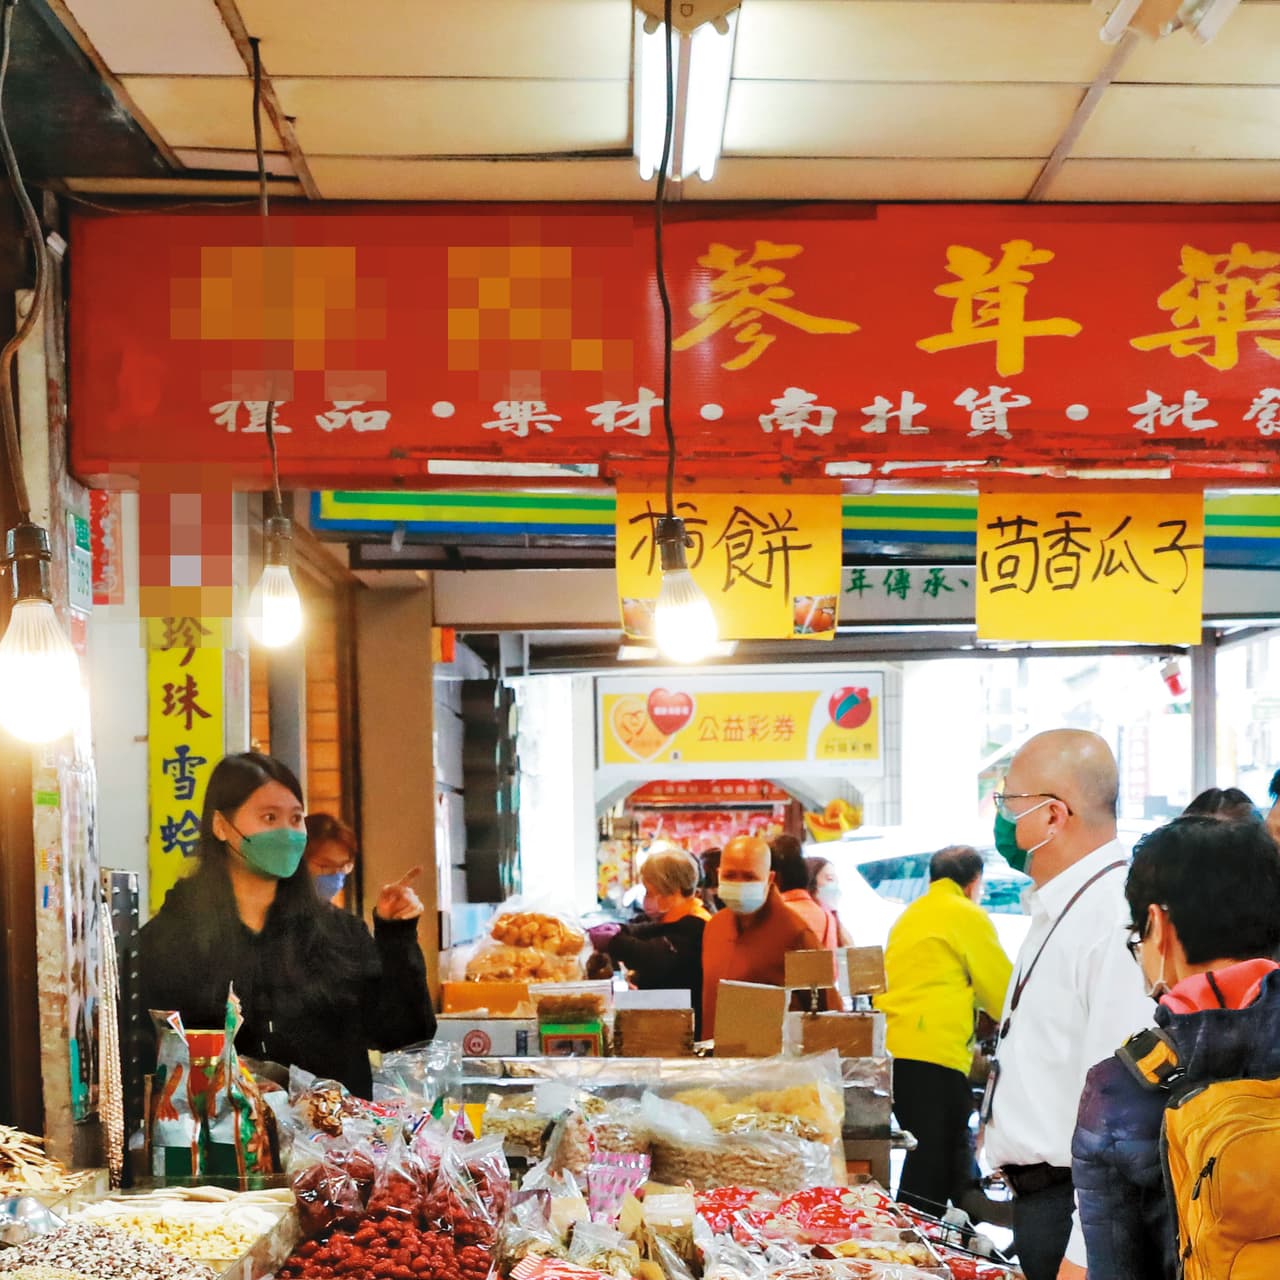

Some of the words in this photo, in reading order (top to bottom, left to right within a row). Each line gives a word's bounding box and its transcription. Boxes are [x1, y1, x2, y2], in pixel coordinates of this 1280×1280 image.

[980, 510, 1204, 595] 茴香瓜子
[697, 714, 796, 743] 公益彩券
